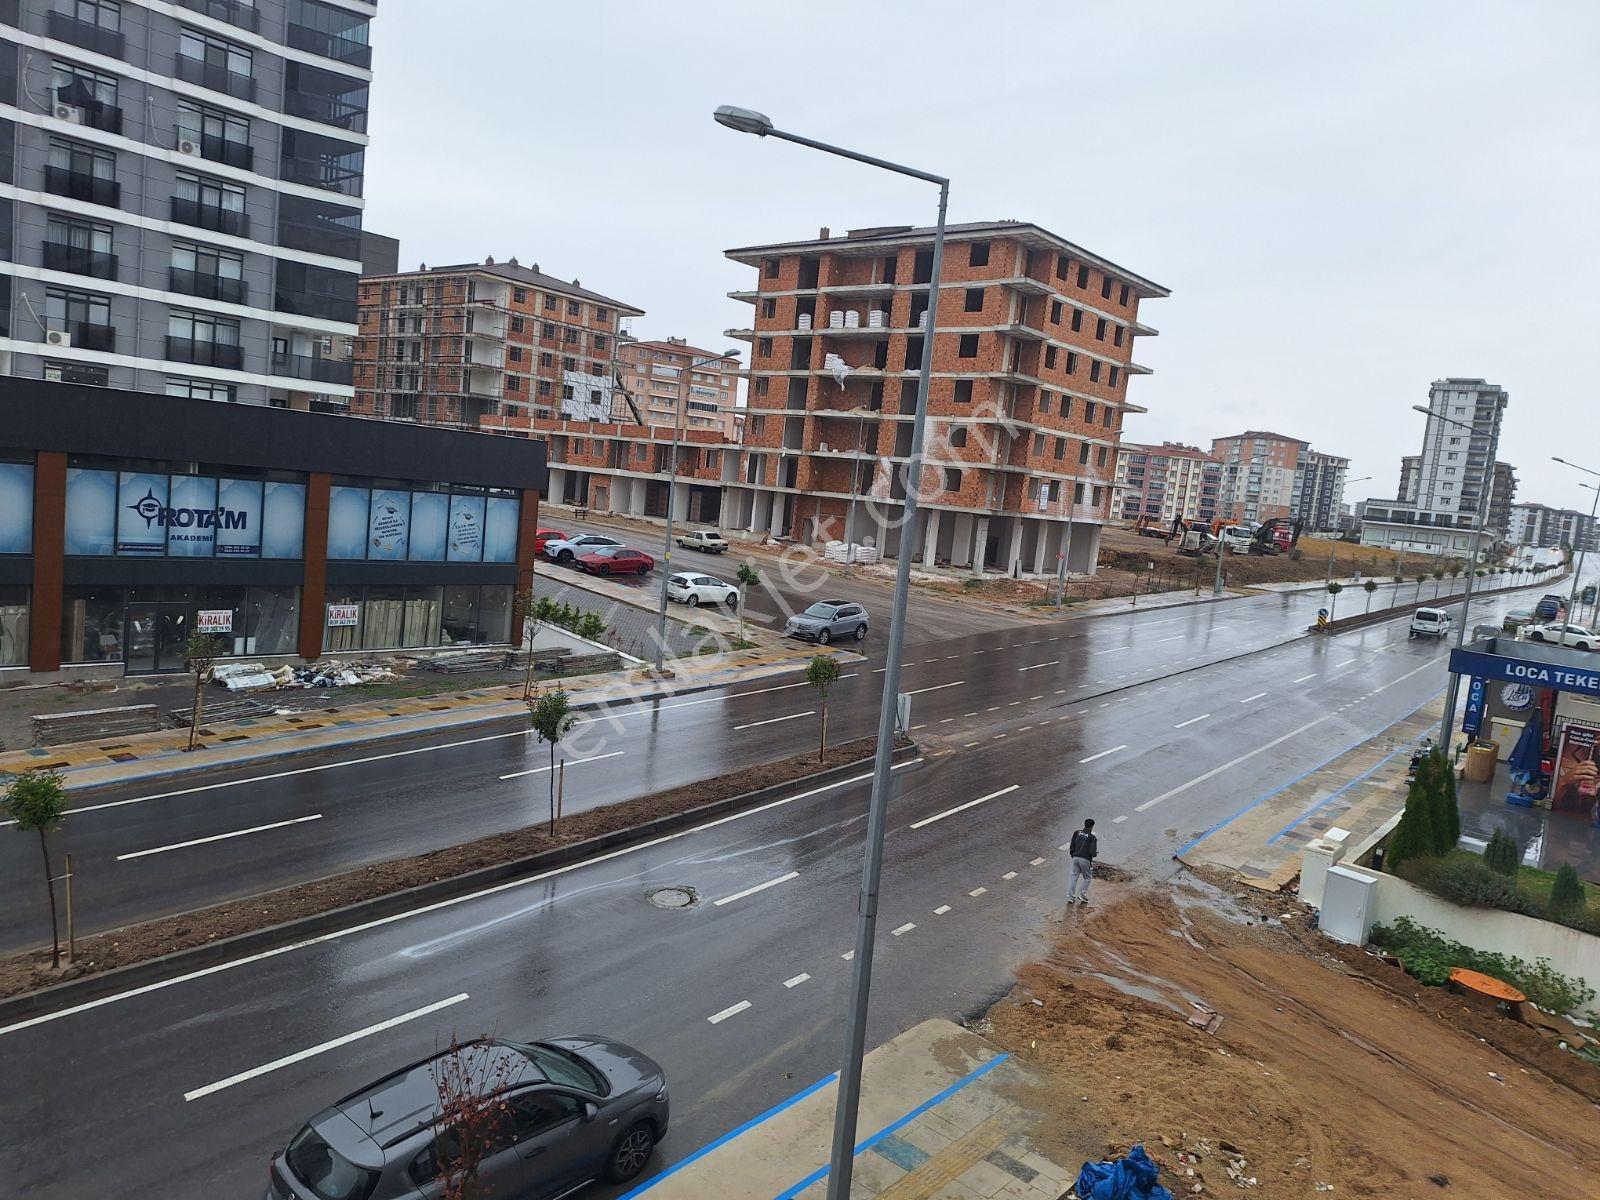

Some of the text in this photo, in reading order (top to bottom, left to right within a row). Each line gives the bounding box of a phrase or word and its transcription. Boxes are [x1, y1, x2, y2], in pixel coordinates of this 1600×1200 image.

[158, 506, 248, 530] ROTA'M
[1505, 664, 1600, 689] LOCA TEKE
[1469, 676, 1483, 713] OCA
